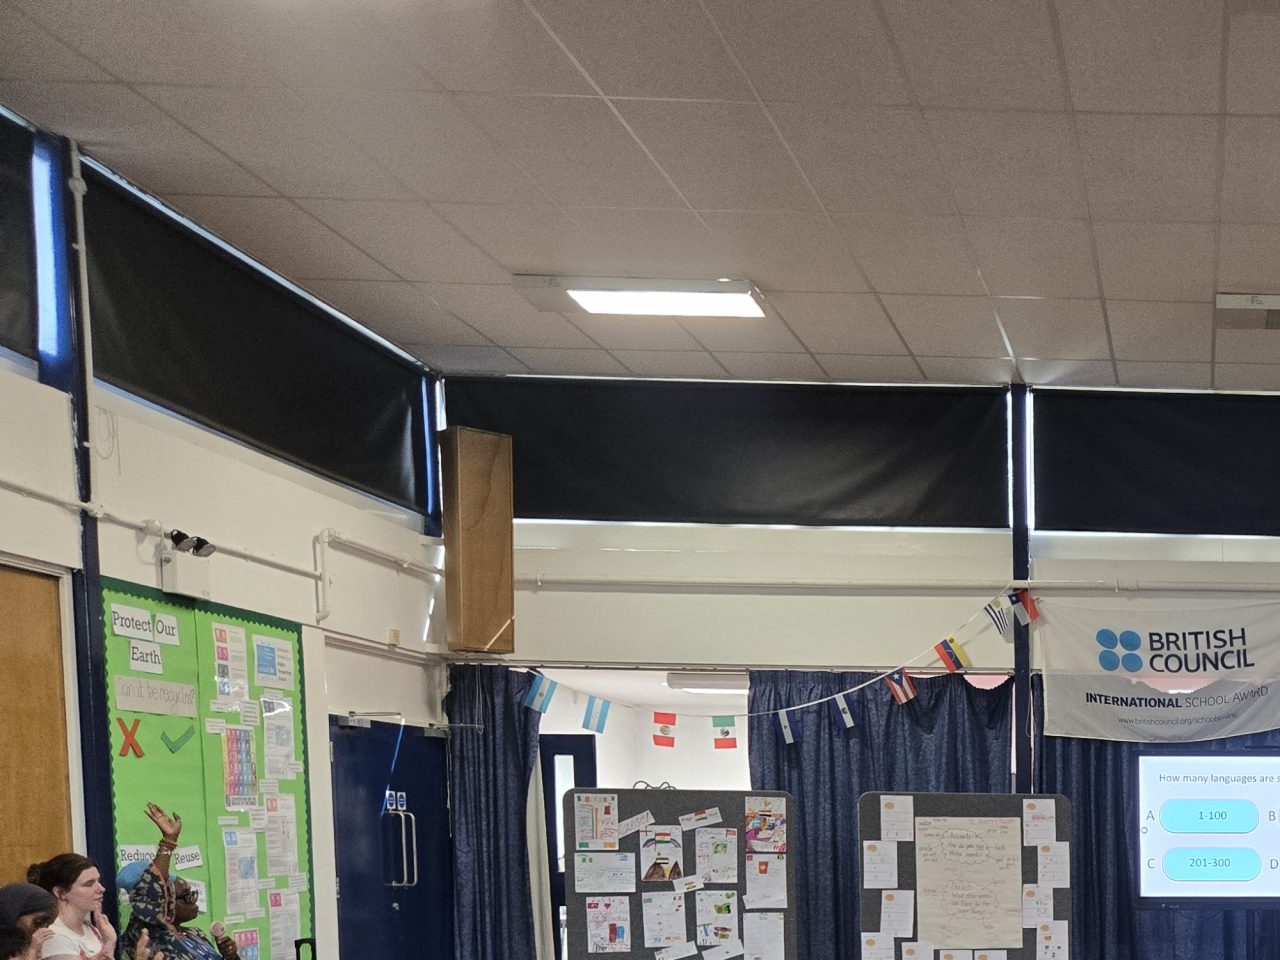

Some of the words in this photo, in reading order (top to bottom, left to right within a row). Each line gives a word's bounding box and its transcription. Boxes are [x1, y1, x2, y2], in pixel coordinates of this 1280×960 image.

[112, 611, 153, 633] Protect
[156, 619, 177, 637] Our
[1148, 627, 1247, 652] BRITISH
[131, 646, 162, 665] Earth
[1149, 648, 1256, 674] COUNCIL
[1085, 692, 1183, 708] INTERNATIONAL
[1185, 695, 1229, 708] SCHOOL
[1232, 685, 1269, 703] AWARD
[1159, 773, 1180, 783] How
[1183, 775, 1208, 785] many
[1210, 773, 1257, 785] languages
[1259, 775, 1275, 783] are
[1146, 810, 1155, 821] A
[1198, 811, 1227, 820] 1-100
[1268, 810, 1276, 821] B
[120, 849, 155, 862] Reduce
[174, 851, 201, 865] Reuse
[1147, 858, 1156, 869] C
[1189, 858, 1231, 867] 201-300
[1270, 858, 1279, 869] D
